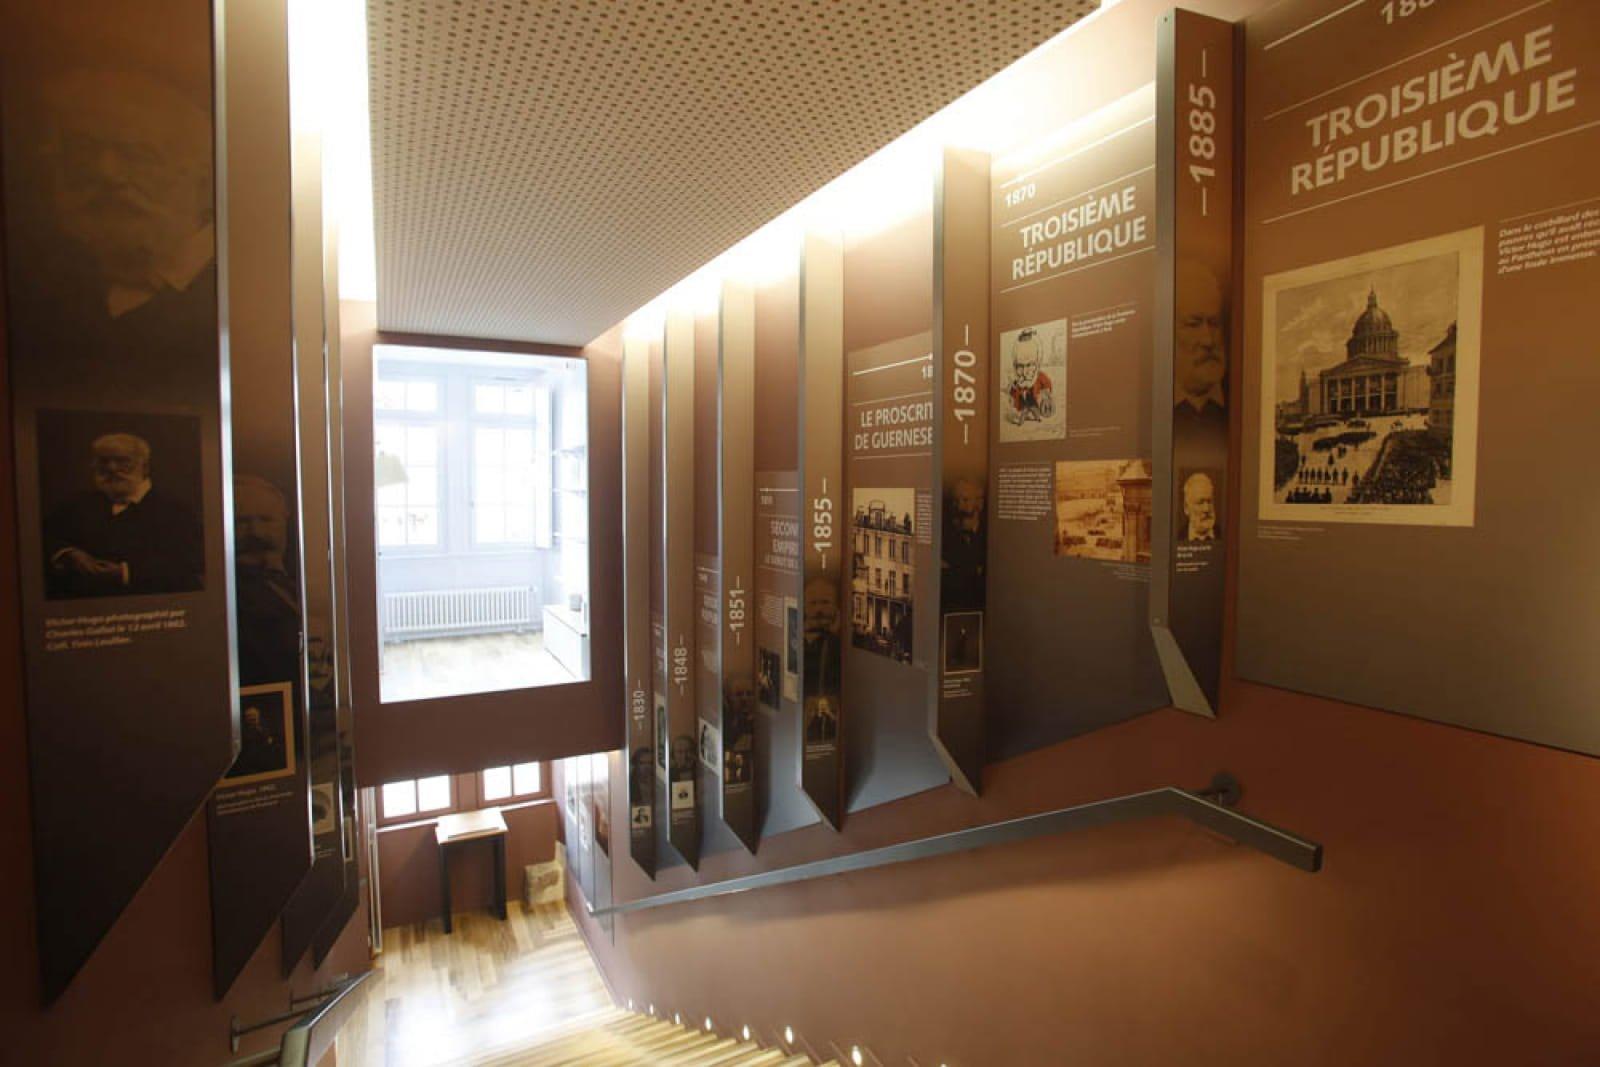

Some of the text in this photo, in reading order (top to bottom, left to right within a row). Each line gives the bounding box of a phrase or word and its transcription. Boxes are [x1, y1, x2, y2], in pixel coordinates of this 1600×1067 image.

[1306, 25, 1553, 147] TROISIÈME
[1189, 83, 1216, 184] 1885
[1290, 68, 1577, 195] RÉPUBLIQUE
[1004, 183, 1036, 207] 1870
[1020, 186, 1136, 248] TROISIÈME
[1012, 216, 1147, 281] RÉPUBLIQUE
[954, 351, 976, 422] 1870
[855, 426, 933, 450] DE GUERNESE
[861, 409, 873, 428] LE
[813, 497, 832, 553] 1855
[729, 588, 745, 633] 1851
[674, 647, 688, 686] 1848
[633, 690, 646, 721] 1830
